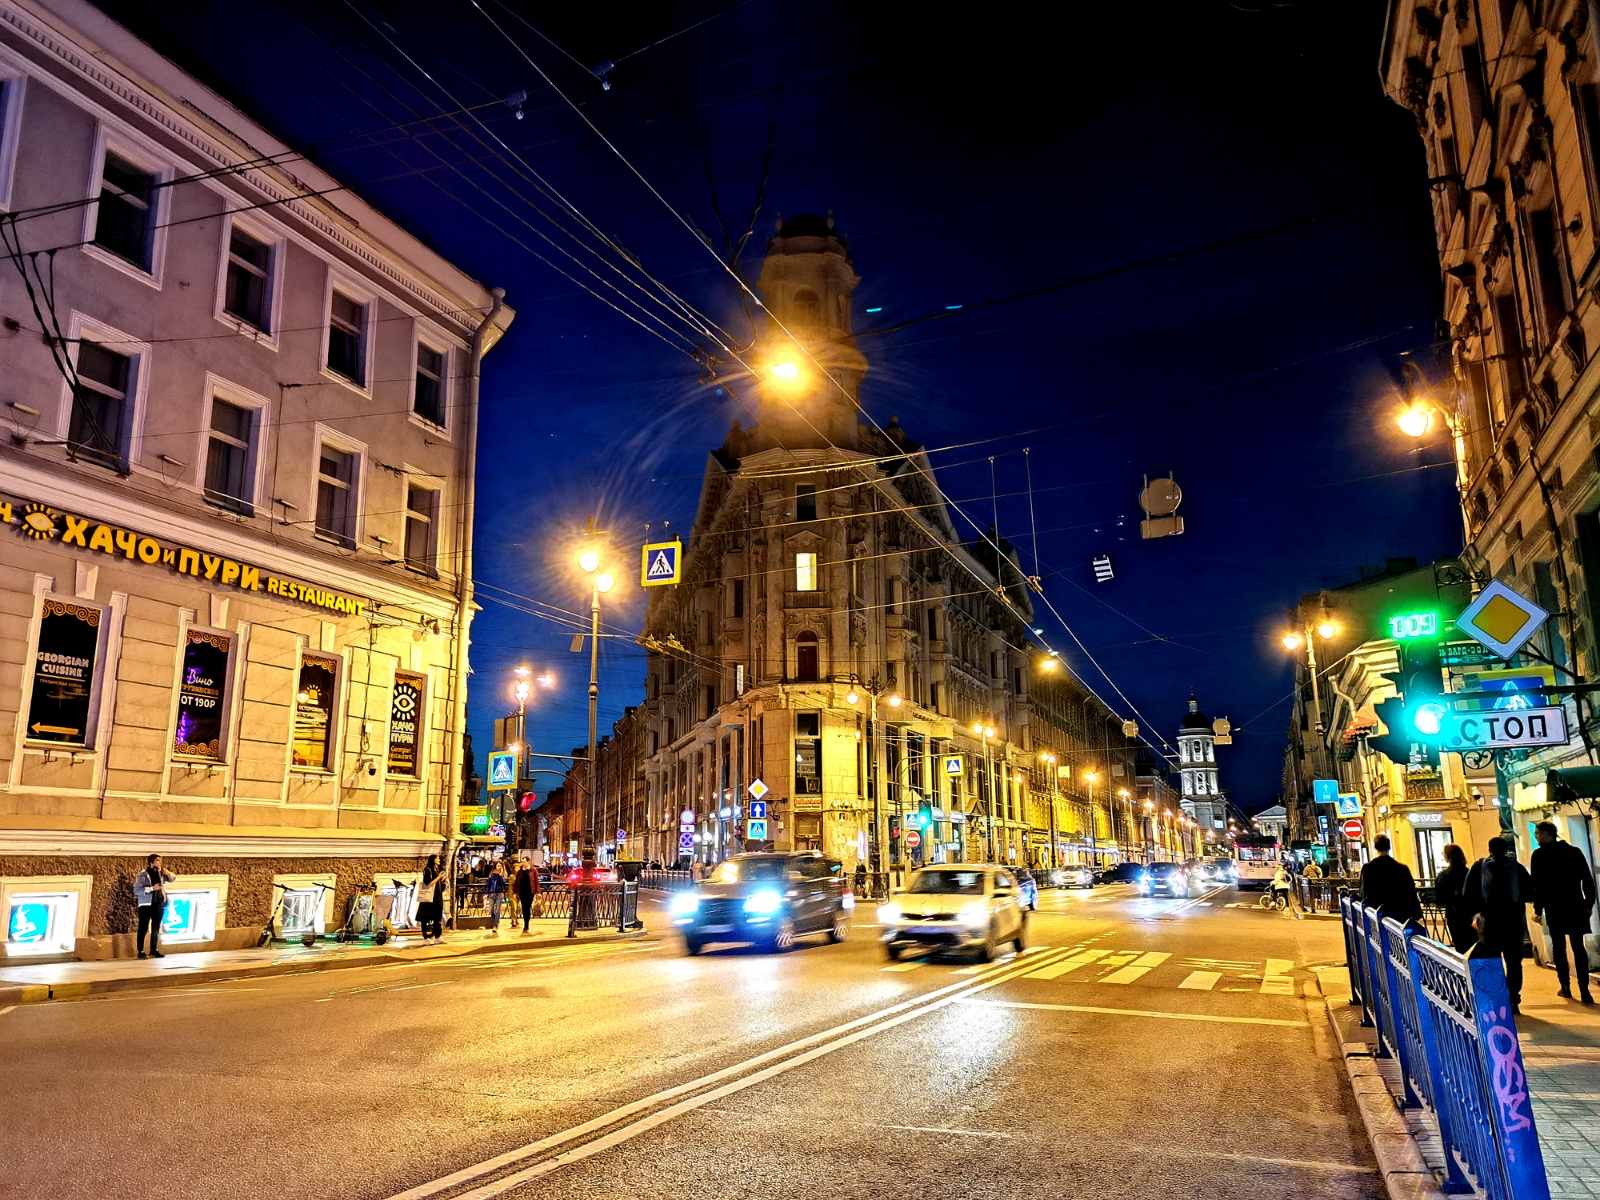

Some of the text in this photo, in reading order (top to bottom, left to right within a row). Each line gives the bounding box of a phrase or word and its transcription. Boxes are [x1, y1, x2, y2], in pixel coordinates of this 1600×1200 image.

[62, 513, 161, 565] ХАЧО
[163, 549, 175, 565] и
[178, 548, 261, 592] ПУРИ
[267, 575, 366, 616] RESTAURANT
[37, 651, 90, 668] GEORGIAN
[41, 663, 83, 677] CUISINE
[180, 695, 194, 705] ОТ
[1460, 715, 1548, 743] СТОП
